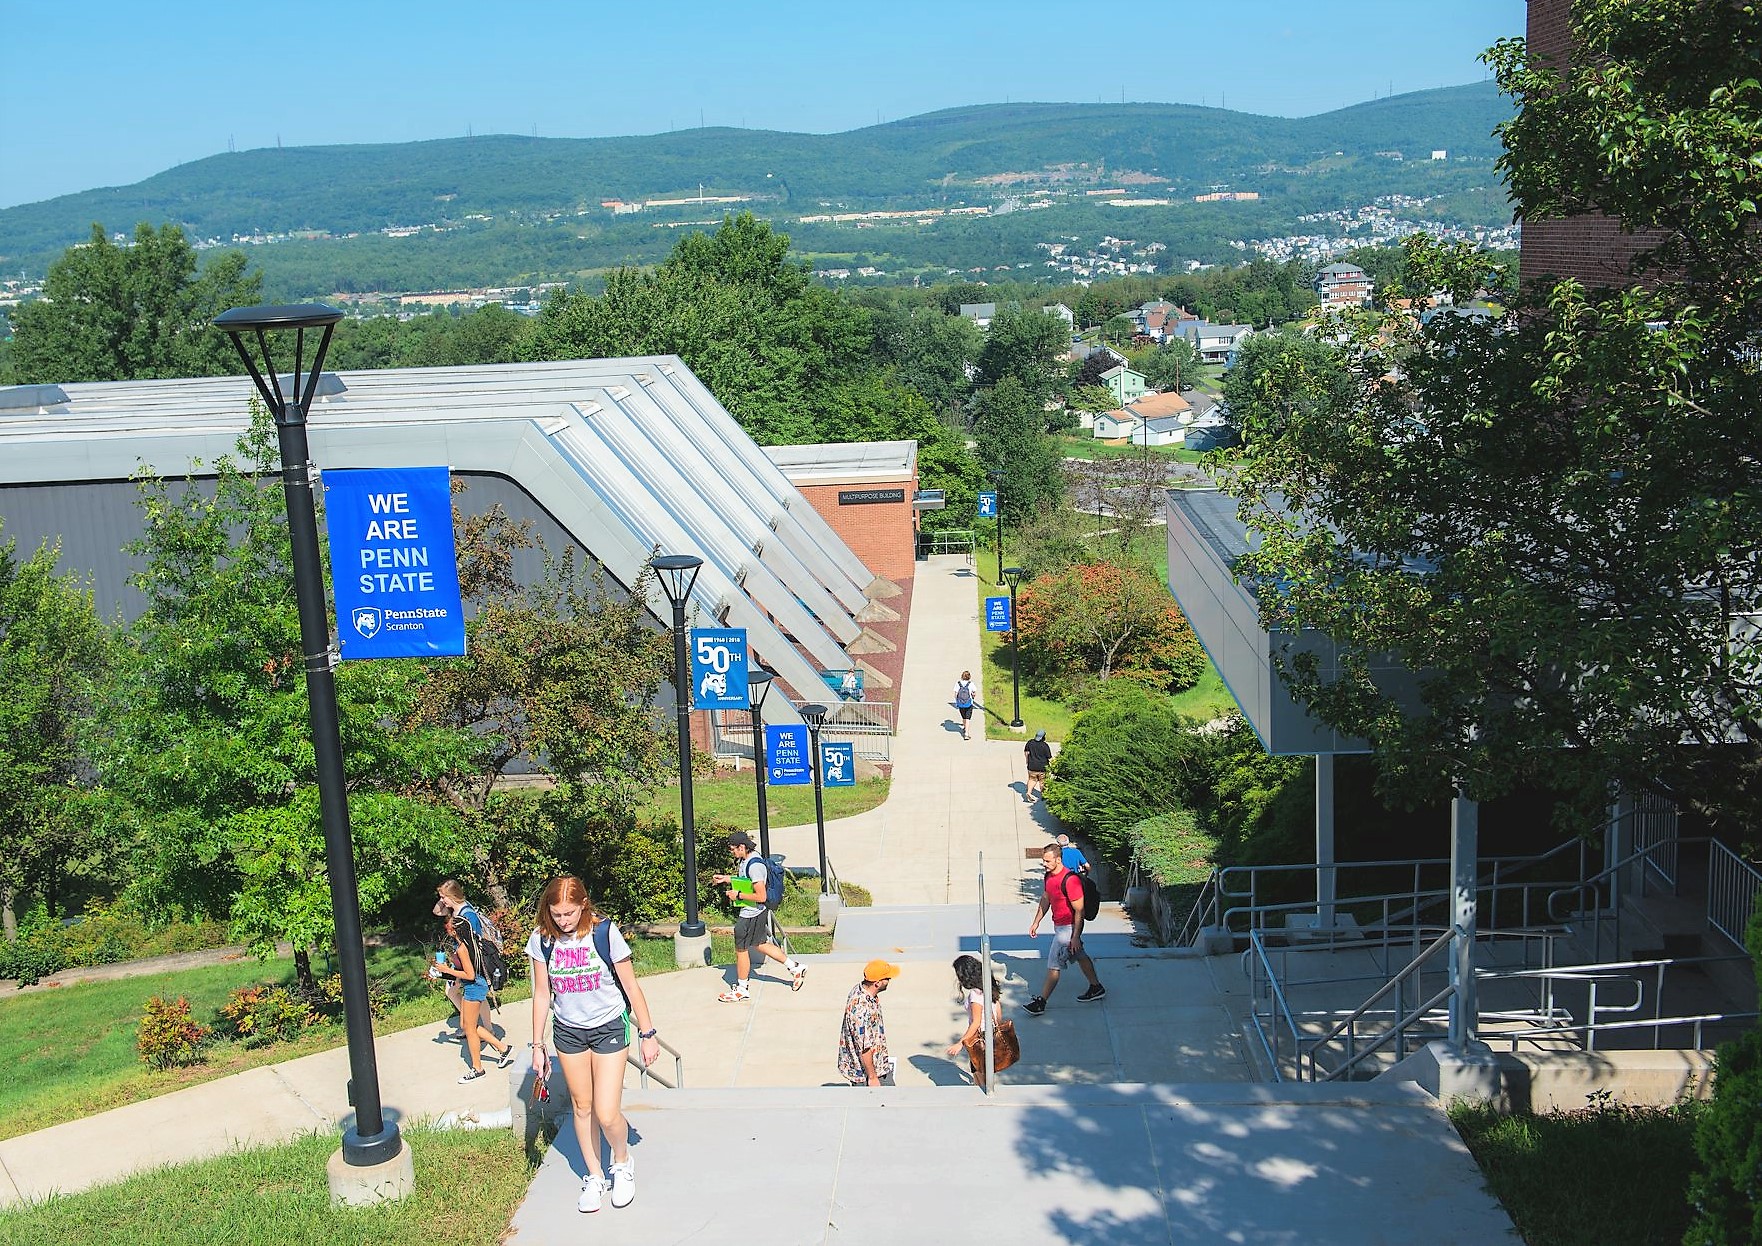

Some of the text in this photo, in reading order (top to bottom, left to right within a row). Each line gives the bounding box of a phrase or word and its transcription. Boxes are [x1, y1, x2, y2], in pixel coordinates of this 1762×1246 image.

[879, 491, 902, 499] BUILDING
[368, 493, 410, 514] WE
[366, 519, 419, 541] ARE
[360, 547, 429, 569] PENN
[359, 571, 435, 594] STATE
[384, 607, 447, 620] PennState
[386, 622, 424, 631] Scranton
[779, 732, 794, 740] WE
[778, 740, 796, 748] ARE
[776, 749, 799, 757] PENN
[775, 757, 801, 765] STATE
[555, 946, 591, 969] PINE
[551, 971, 603, 994] OREST
